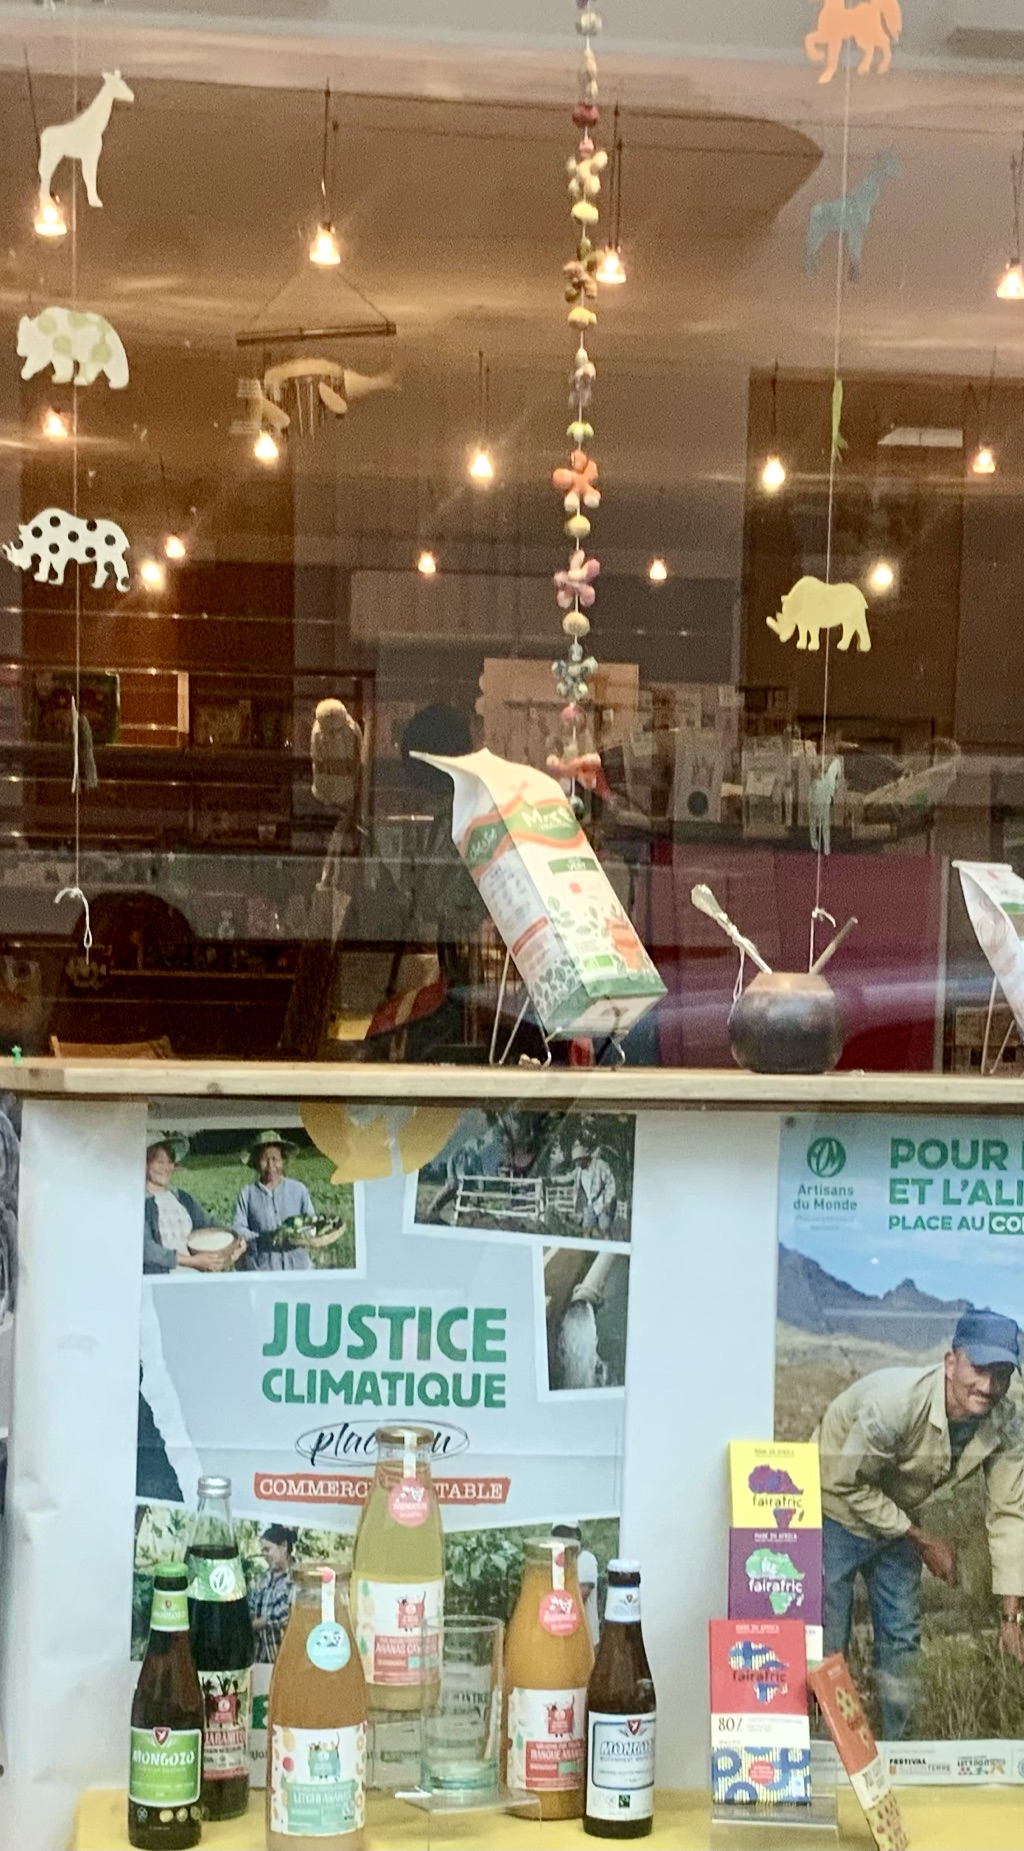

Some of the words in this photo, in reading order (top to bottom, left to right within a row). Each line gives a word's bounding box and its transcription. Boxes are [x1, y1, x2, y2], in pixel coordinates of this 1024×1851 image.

[889, 1138, 1009, 1171] POUR
[797, 1184, 854, 1196] Artisans
[888, 1178, 934, 1205] ET
[793, 1198, 810, 1210] du
[813, 1198, 858, 1211] Monde
[888, 1215, 952, 1231] PLACE
[957, 1216, 985, 1232] AU
[262, 1302, 507, 1362] JUSTICE
[261, 1368, 506, 1408] CLIMATIQUE
[310, 1423, 377, 1467] plac
[260, 1479, 370, 1498] COMMERC
[435, 1481, 503, 1498] TABLE
[748, 1577, 803, 1593] fairafric
[132, 1749, 195, 1767] MONGOZO
